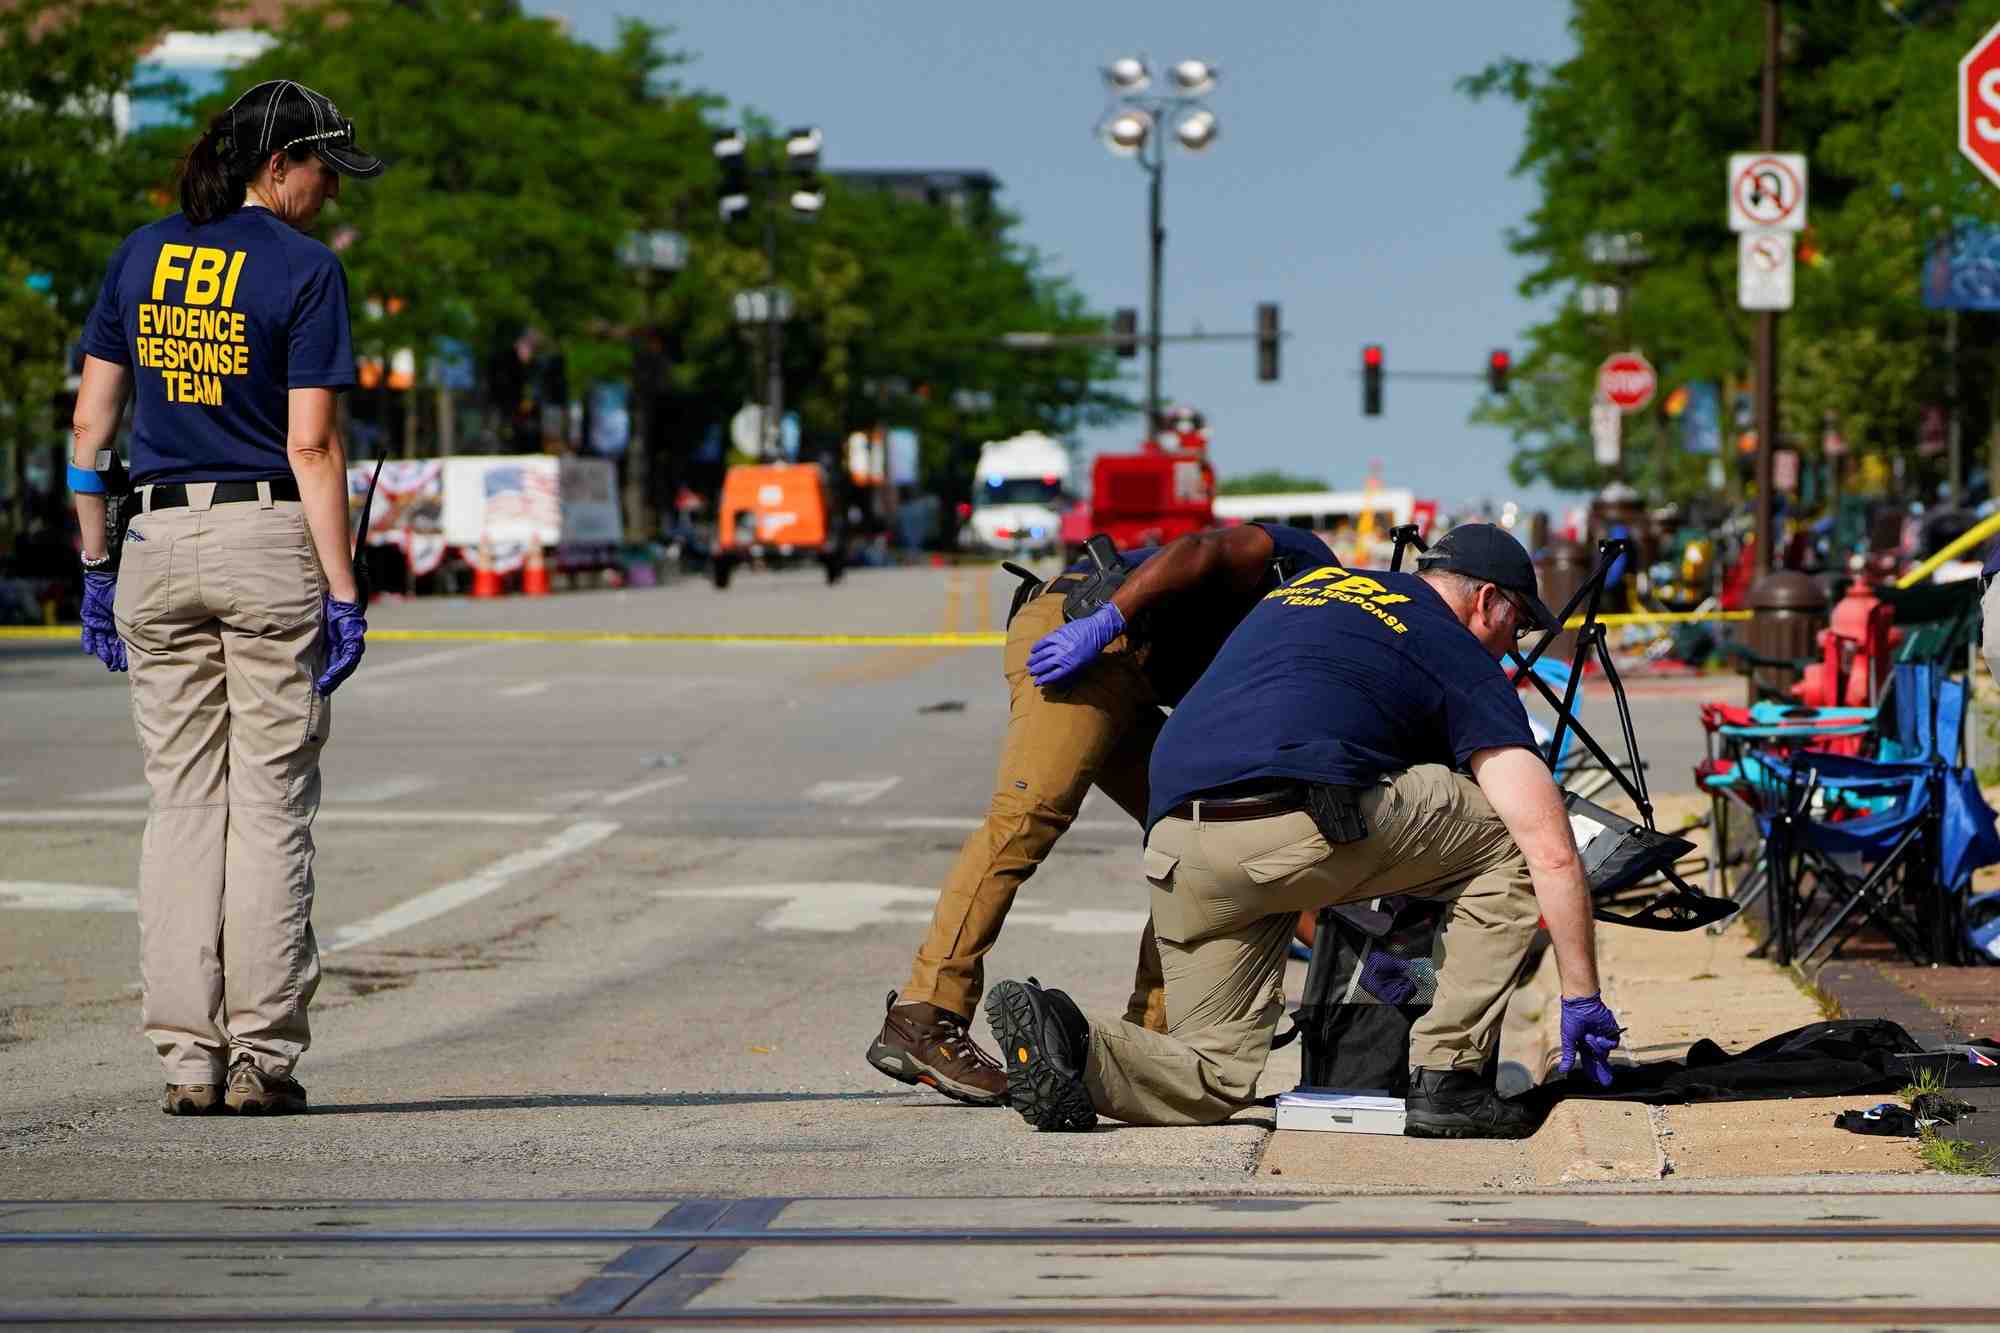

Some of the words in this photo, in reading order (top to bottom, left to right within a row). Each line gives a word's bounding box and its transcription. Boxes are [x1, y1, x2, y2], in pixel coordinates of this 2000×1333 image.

[152, 243, 247, 308] FBI
[139, 304, 246, 342] EVIDENCE
[136, 336, 249, 375] RESPONSE
[162, 370, 223, 406] TEAM
[1282, 595, 1328, 606] TEAM
[1289, 566, 1412, 606] FBI
[1317, 589, 1408, 635] RESPONSE
